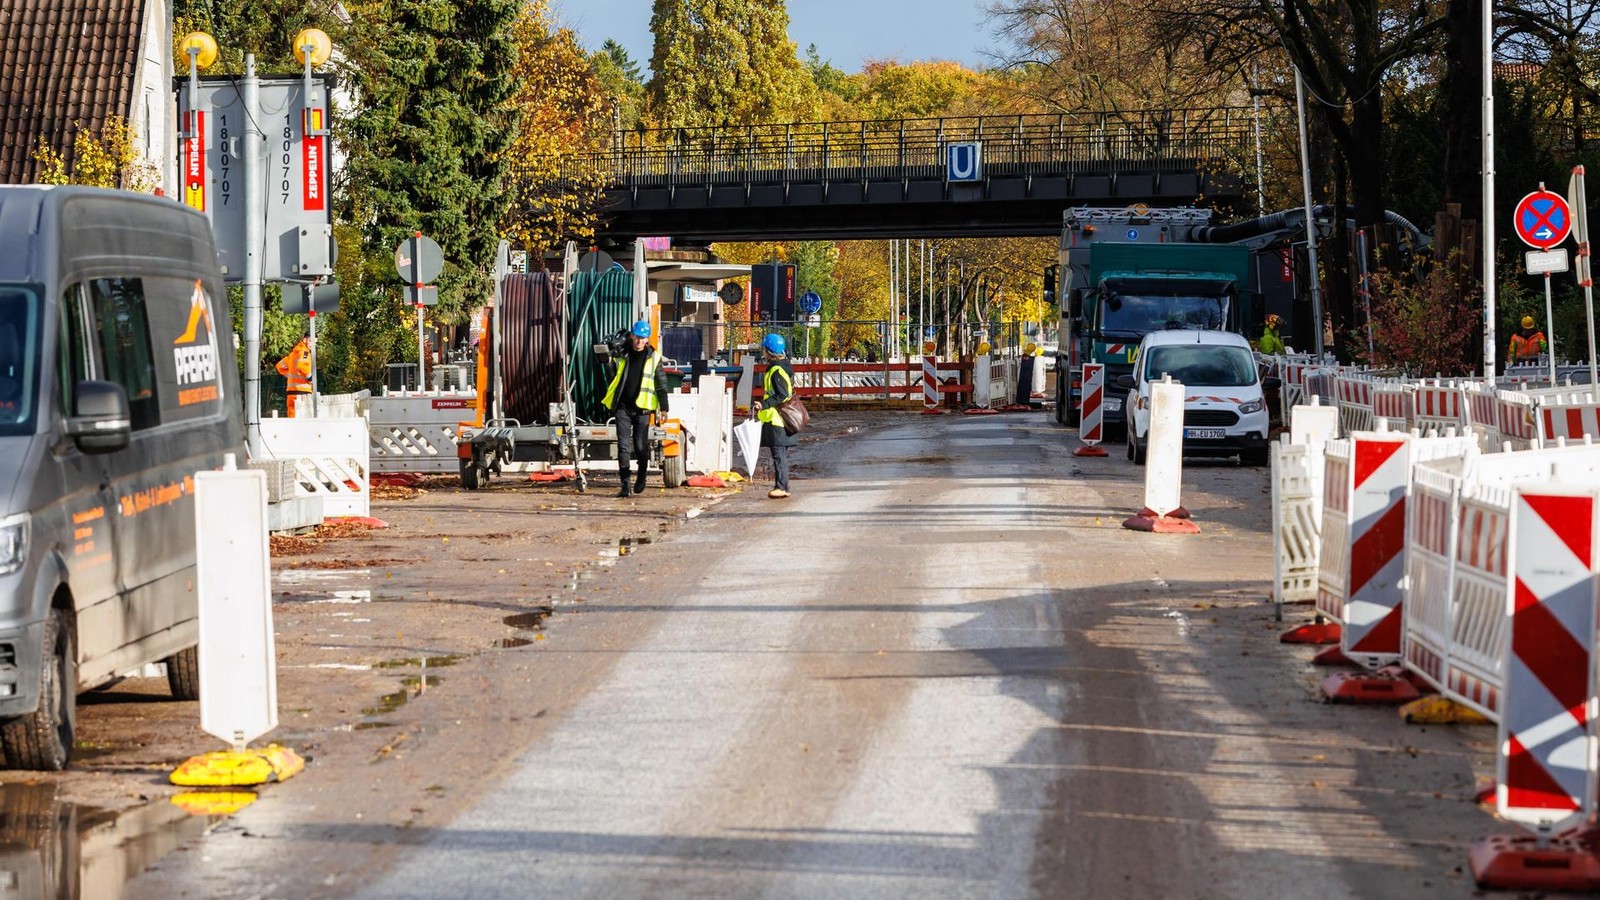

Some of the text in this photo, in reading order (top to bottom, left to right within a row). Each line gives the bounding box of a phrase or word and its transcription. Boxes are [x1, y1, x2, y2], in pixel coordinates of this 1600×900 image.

[220, 114, 230, 206] 1800707
[281, 113, 291, 205] 1800707
[308, 144, 318, 199] ZEPPELIN
[952, 145, 973, 179] U
